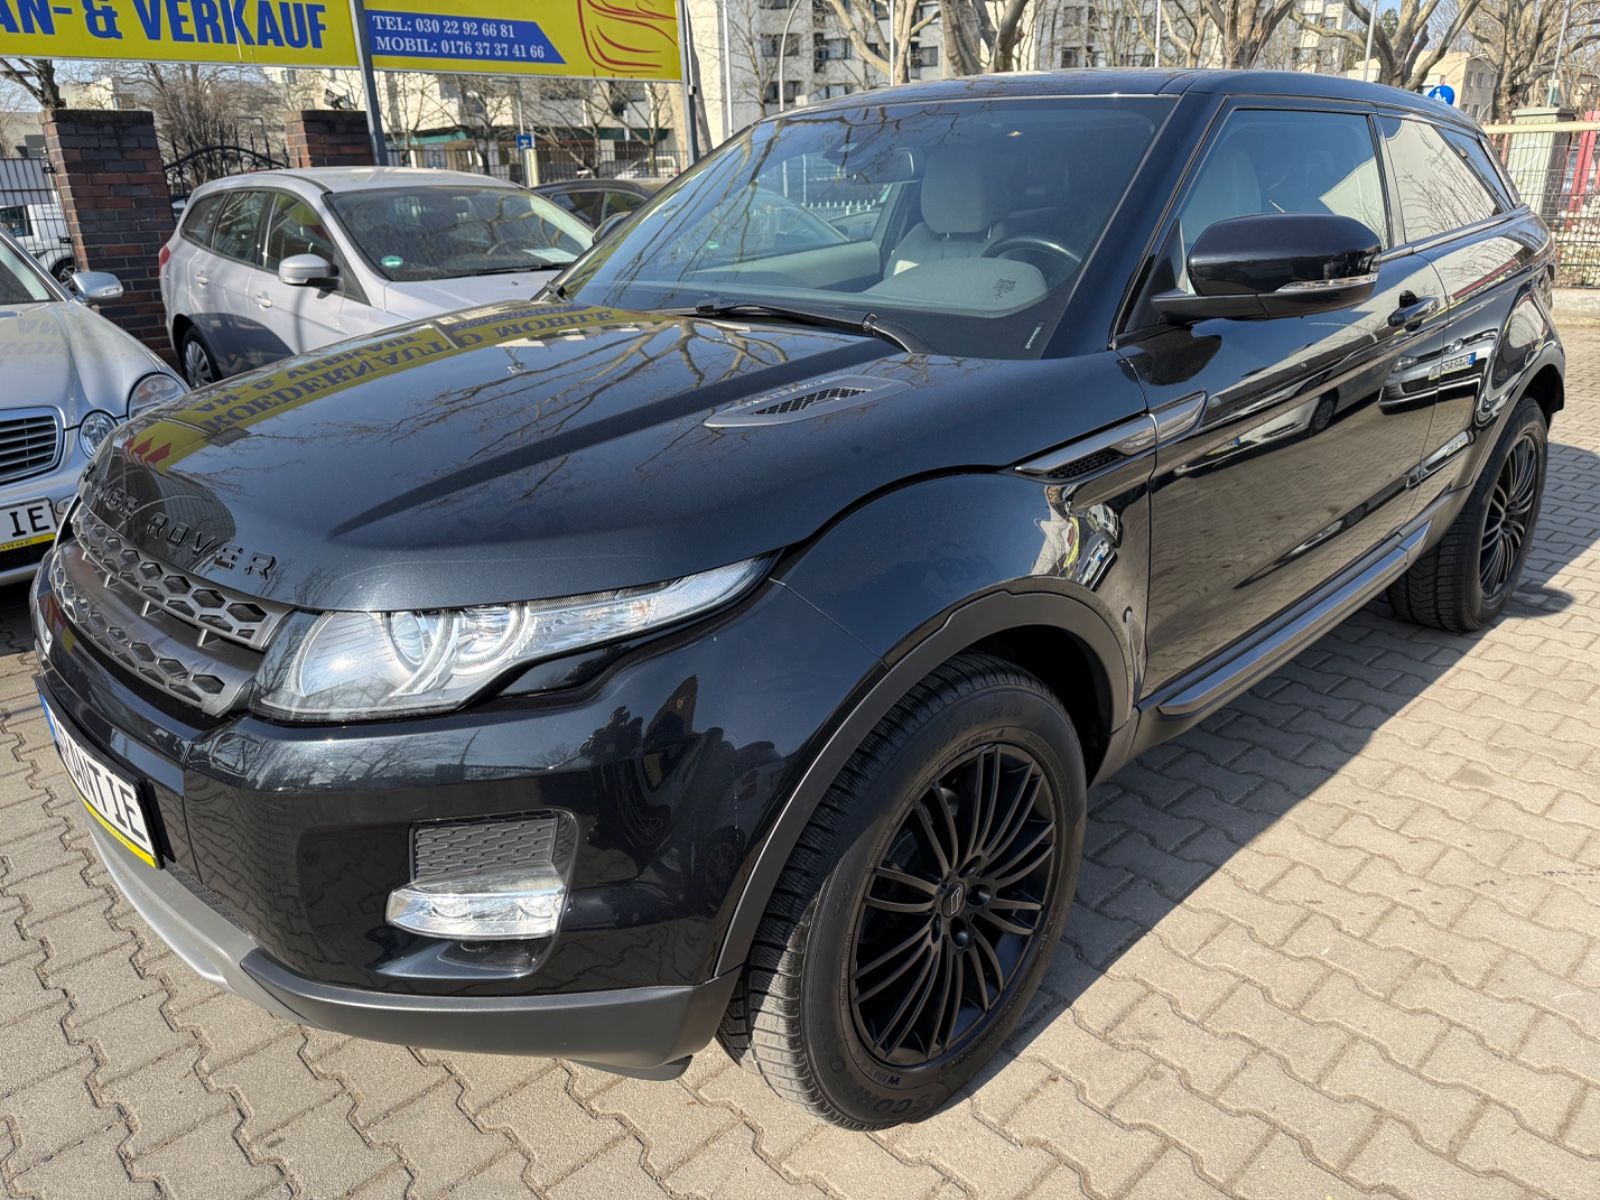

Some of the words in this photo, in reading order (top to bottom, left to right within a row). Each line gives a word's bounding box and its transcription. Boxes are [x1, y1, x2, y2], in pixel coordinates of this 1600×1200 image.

[84, 0, 123, 40] &
[132, 0, 327, 49] VERKAUF
[372, 15, 412, 32] TEL:
[415, 18, 440, 34] 030
[443, 20, 460, 35] 22
[463, 22, 479, 36] 92
[482, 23, 497, 37] 66
[500, 24, 515, 38] 81
[375, 36, 438, 53] MOBIL:
[441, 42, 473, 55] 0176
[475, 43, 491, 56] 37
[494, 44, 509, 57] 37
[512, 44, 527, 58] 41
[530, 45, 545, 59] 66
[147, 512, 277, 580] ROVER
